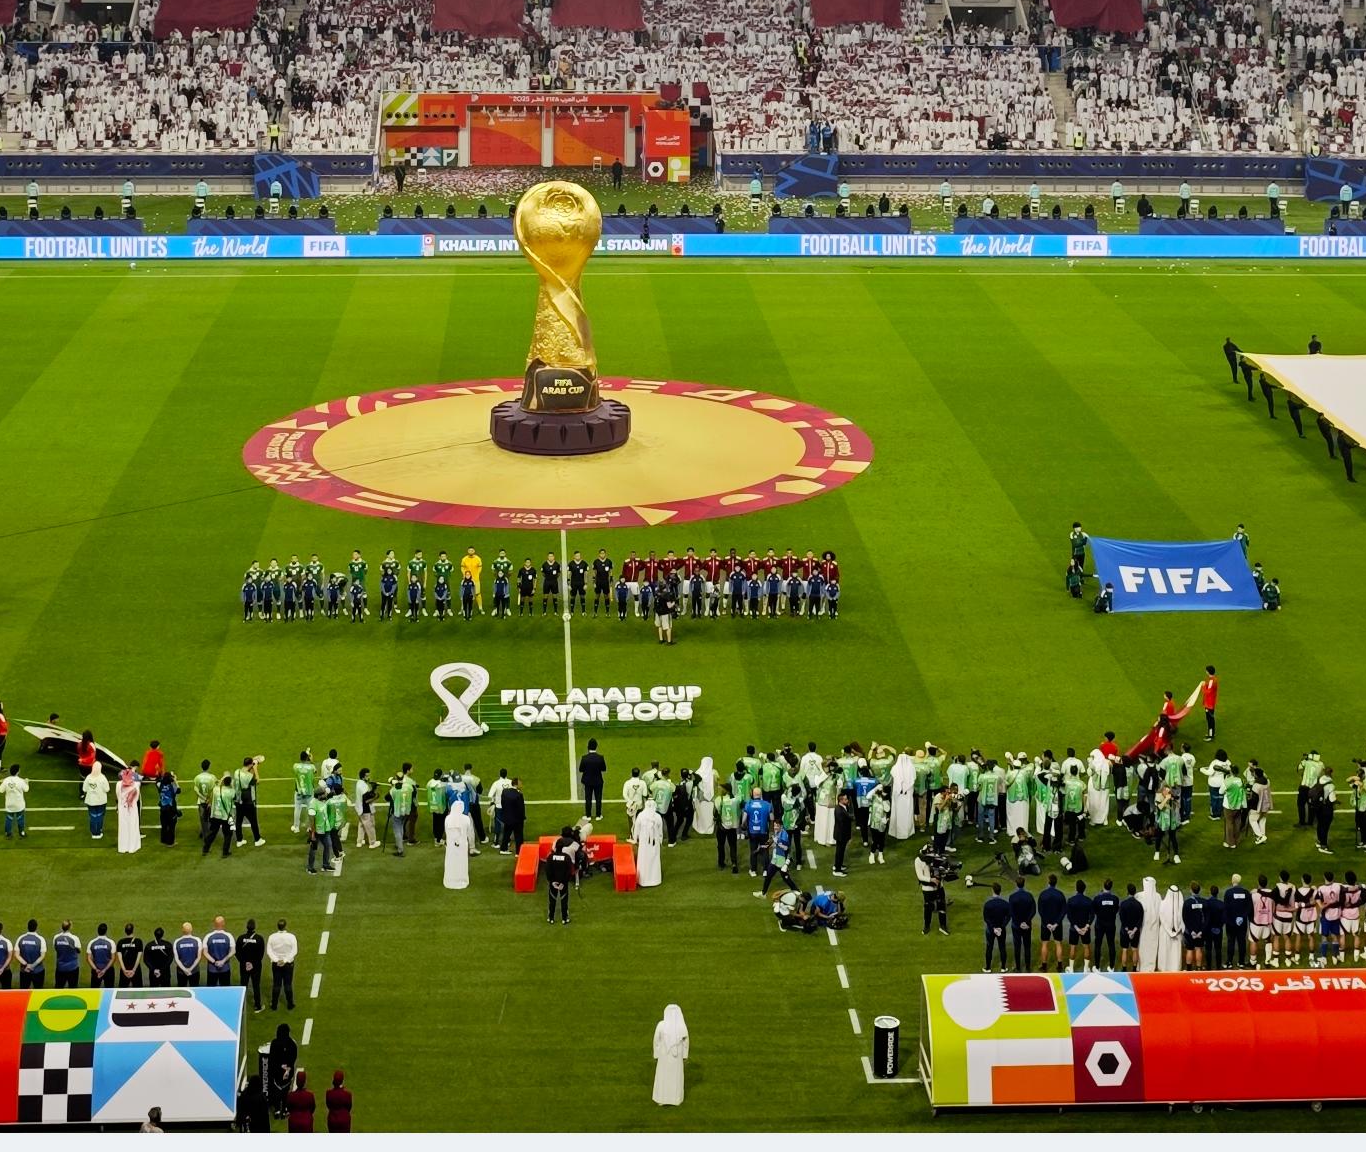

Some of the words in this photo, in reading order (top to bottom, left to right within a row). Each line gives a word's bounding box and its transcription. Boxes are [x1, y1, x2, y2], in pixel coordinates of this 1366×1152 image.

[25, 236, 106, 258] FOOTBALL
[110, 236, 167, 258] UNITES
[192, 237, 220, 257] the
[222, 236, 270, 258] World
[309, 241, 339, 252] FIFA
[439, 239, 497, 252] KHALIFA
[607, 239, 668, 251] STADIUM
[801, 234, 878, 256] FOOTBALL
[882, 234, 936, 256] UNITES
[961, 235, 986, 255] the
[988, 234, 1034, 256] World
[1073, 240, 1102, 251] FIFA
[542, 386, 566, 395] ARAB
[568, 385, 585, 395] CUP
[554, 378, 573, 387] FIFA
[1118, 565, 1234, 594] FIFA
[500, 688, 559, 706] FIFA
[566, 686, 643, 704] ARAB
[649, 685, 702, 703] CUP
[513, 703, 610, 728] QATAR
[616, 701, 693, 723] 2025
[1269, 975, 1316, 994] قطر
[886, 1031, 895, 1075] POWERADE
